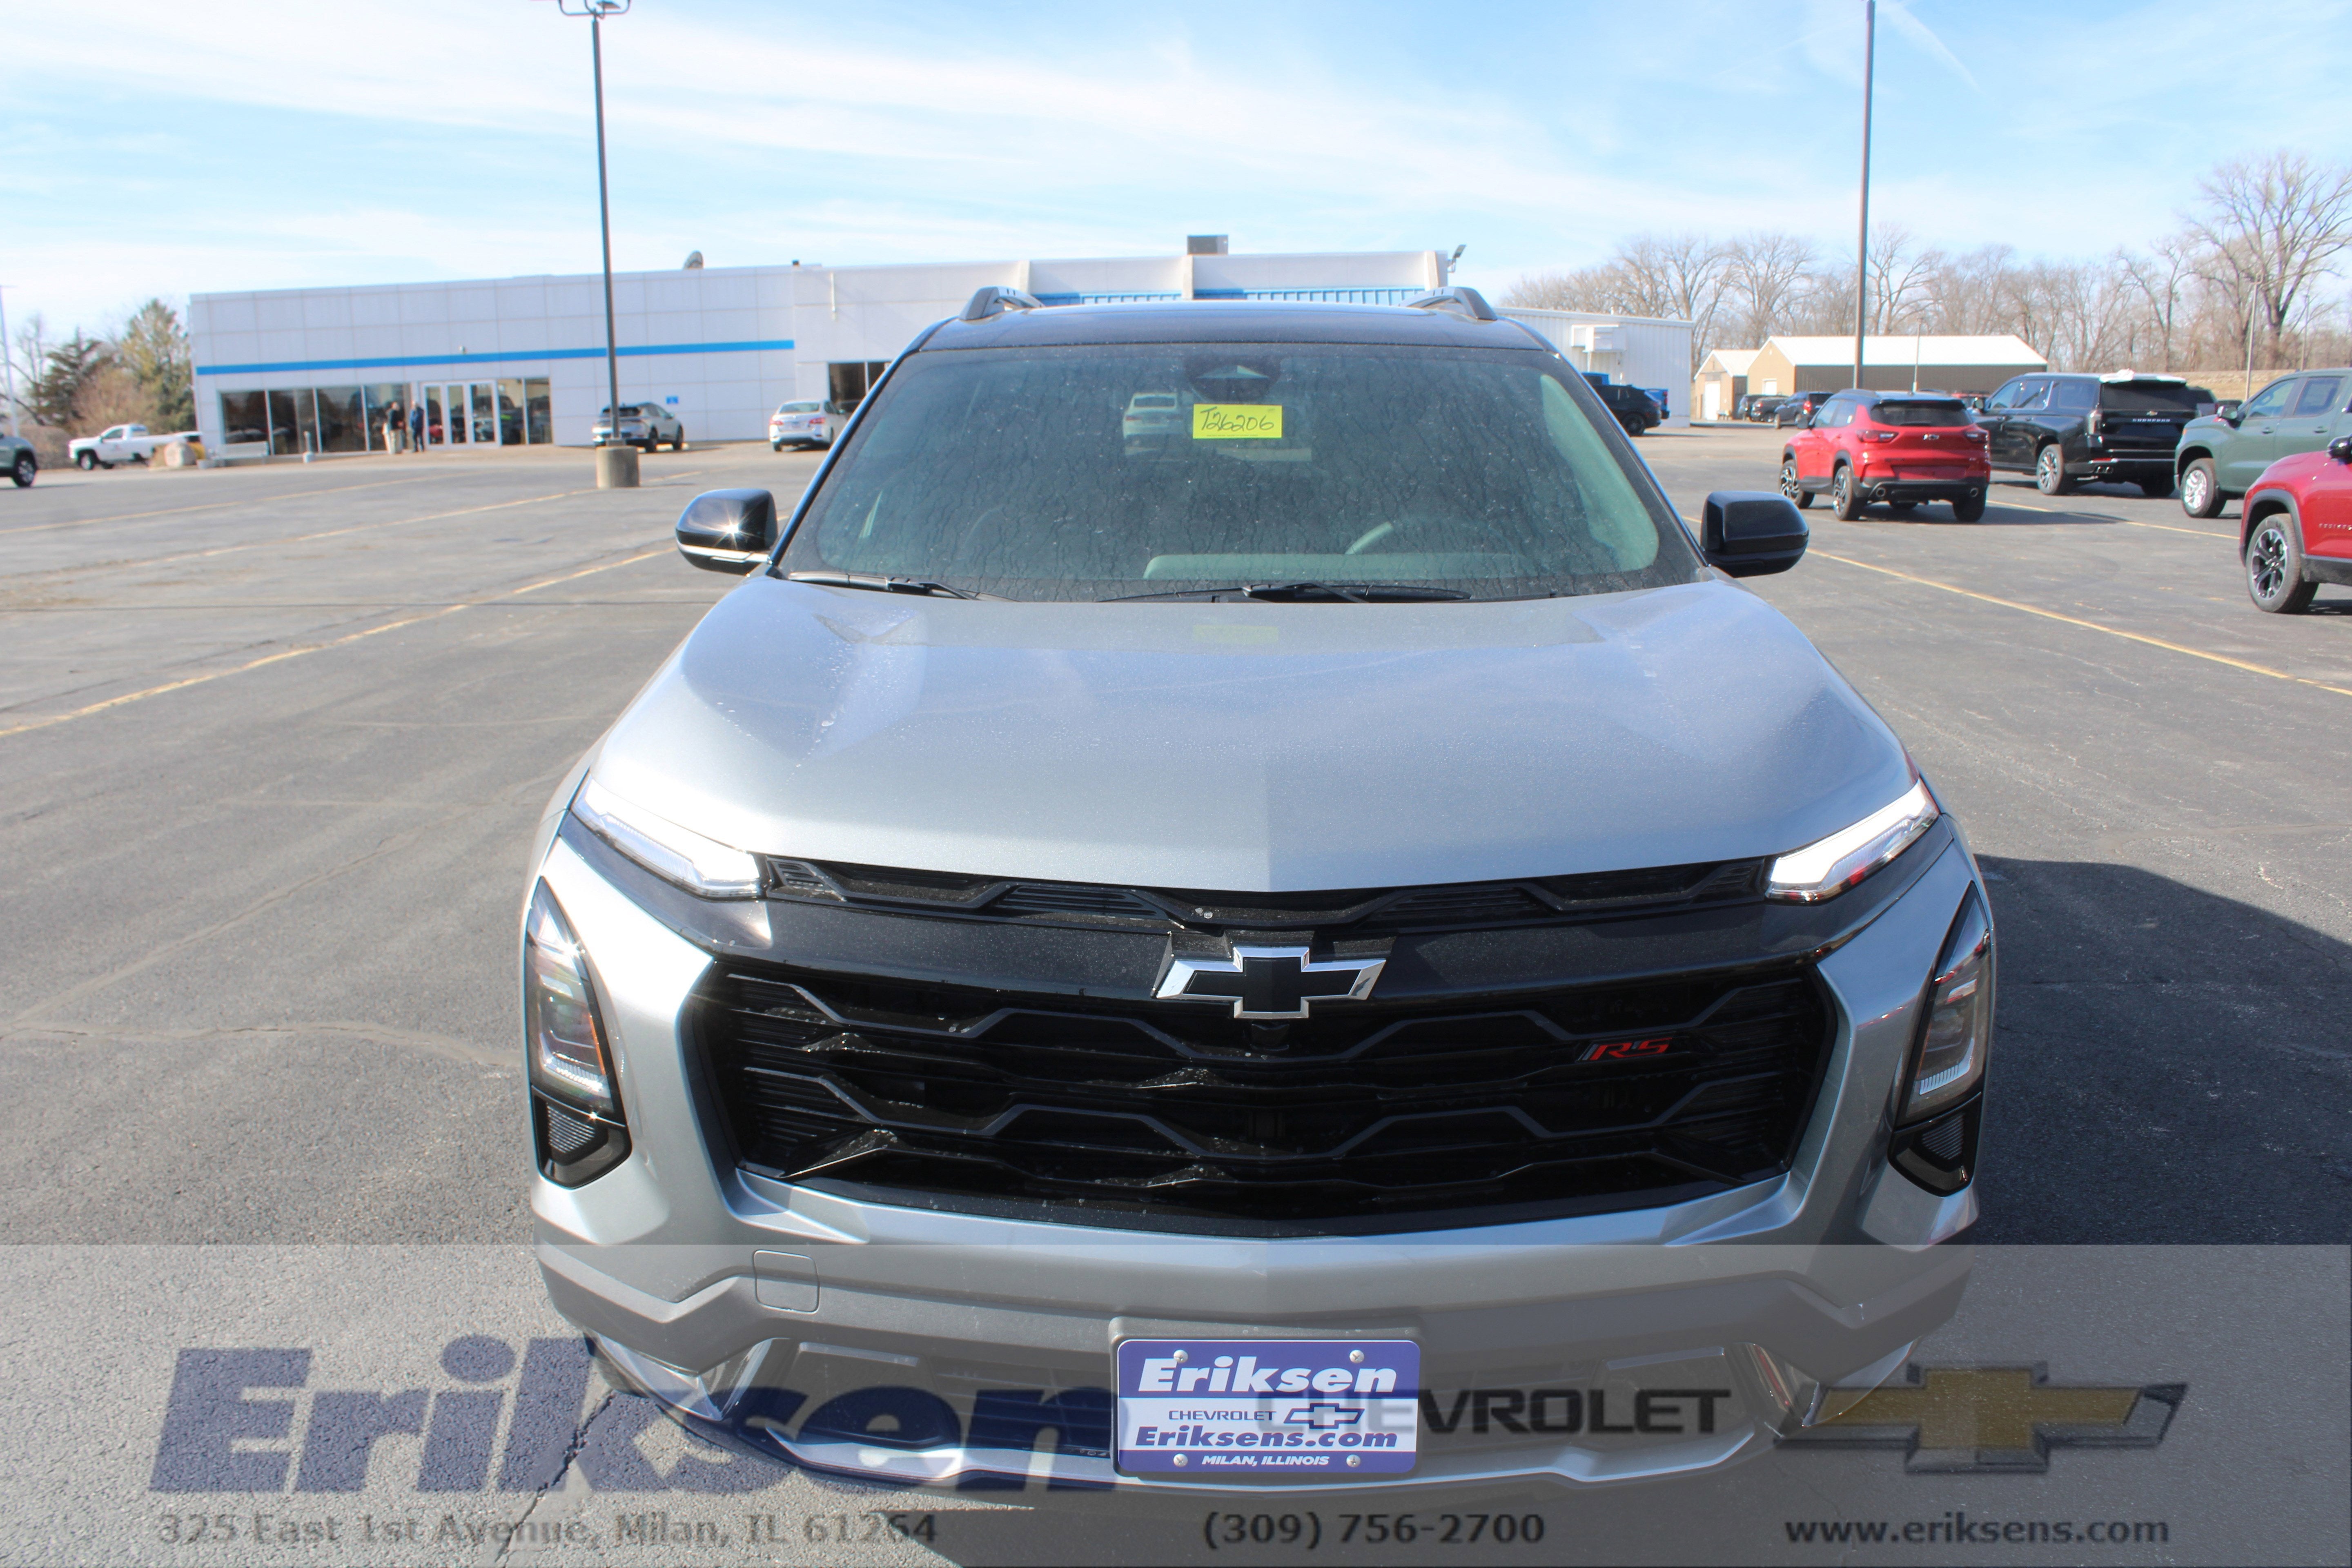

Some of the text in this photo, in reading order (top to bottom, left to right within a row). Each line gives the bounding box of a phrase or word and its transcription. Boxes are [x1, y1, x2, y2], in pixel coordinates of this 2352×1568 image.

[1200, 406, 1274, 432] T26206
[1583, 1037, 1673, 1061] RS
[1138, 1355, 1397, 1393] Eriksen
[1168, 1410, 1277, 1421] CHEVROLET
[1135, 1424, 1398, 1448] Eriksens.com
[1201, 1454, 1330, 1466] MILAN, ILLINOIS
